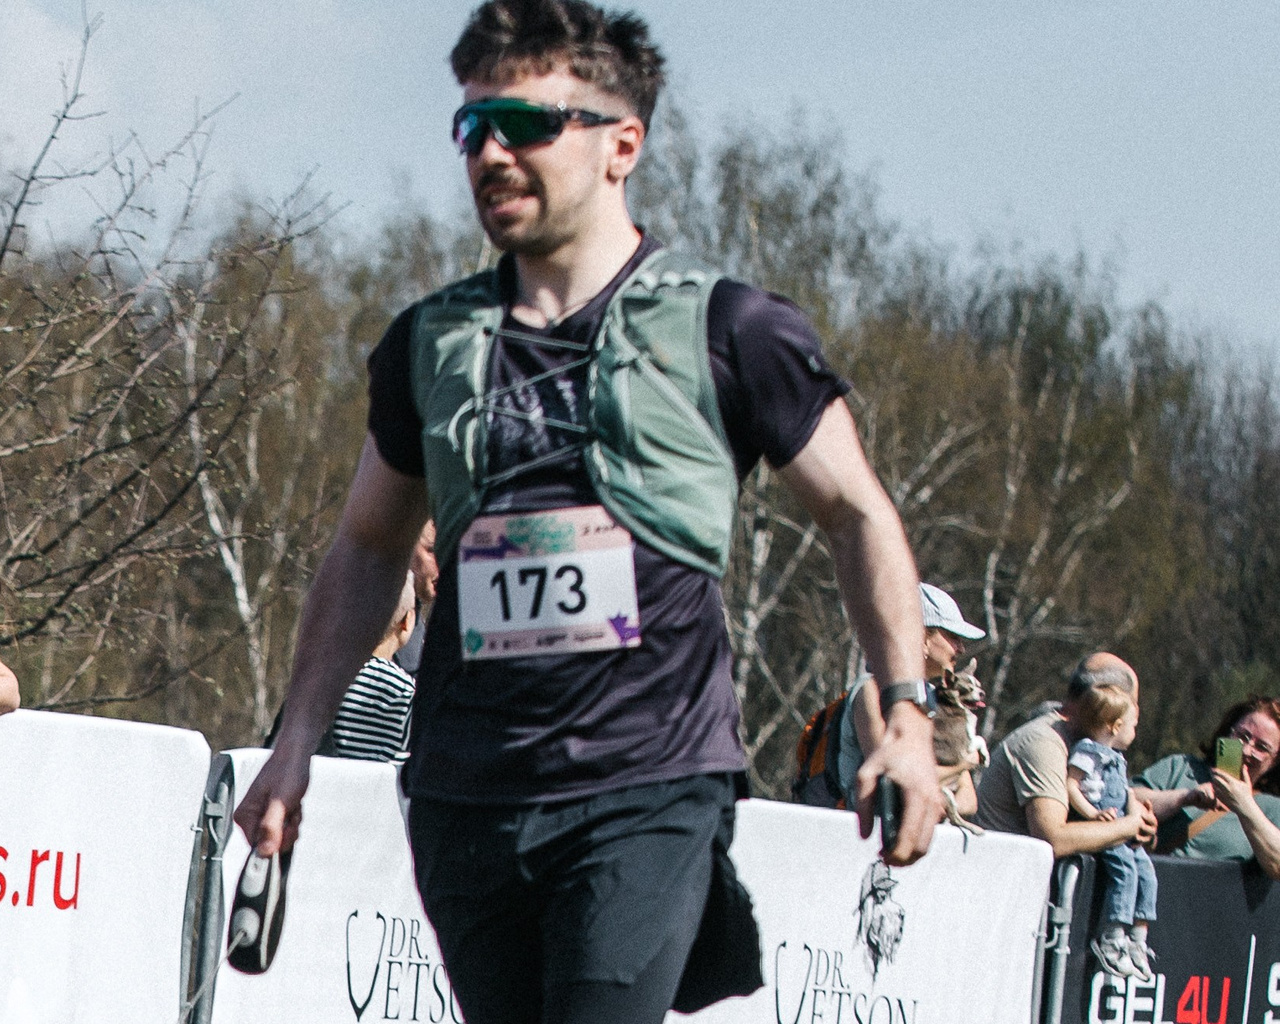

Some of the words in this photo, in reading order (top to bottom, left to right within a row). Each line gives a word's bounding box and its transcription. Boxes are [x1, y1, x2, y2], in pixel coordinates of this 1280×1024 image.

[490, 564, 587, 622] 173
[389, 917, 429, 960] DR.
[815, 948, 850, 990] DR.
